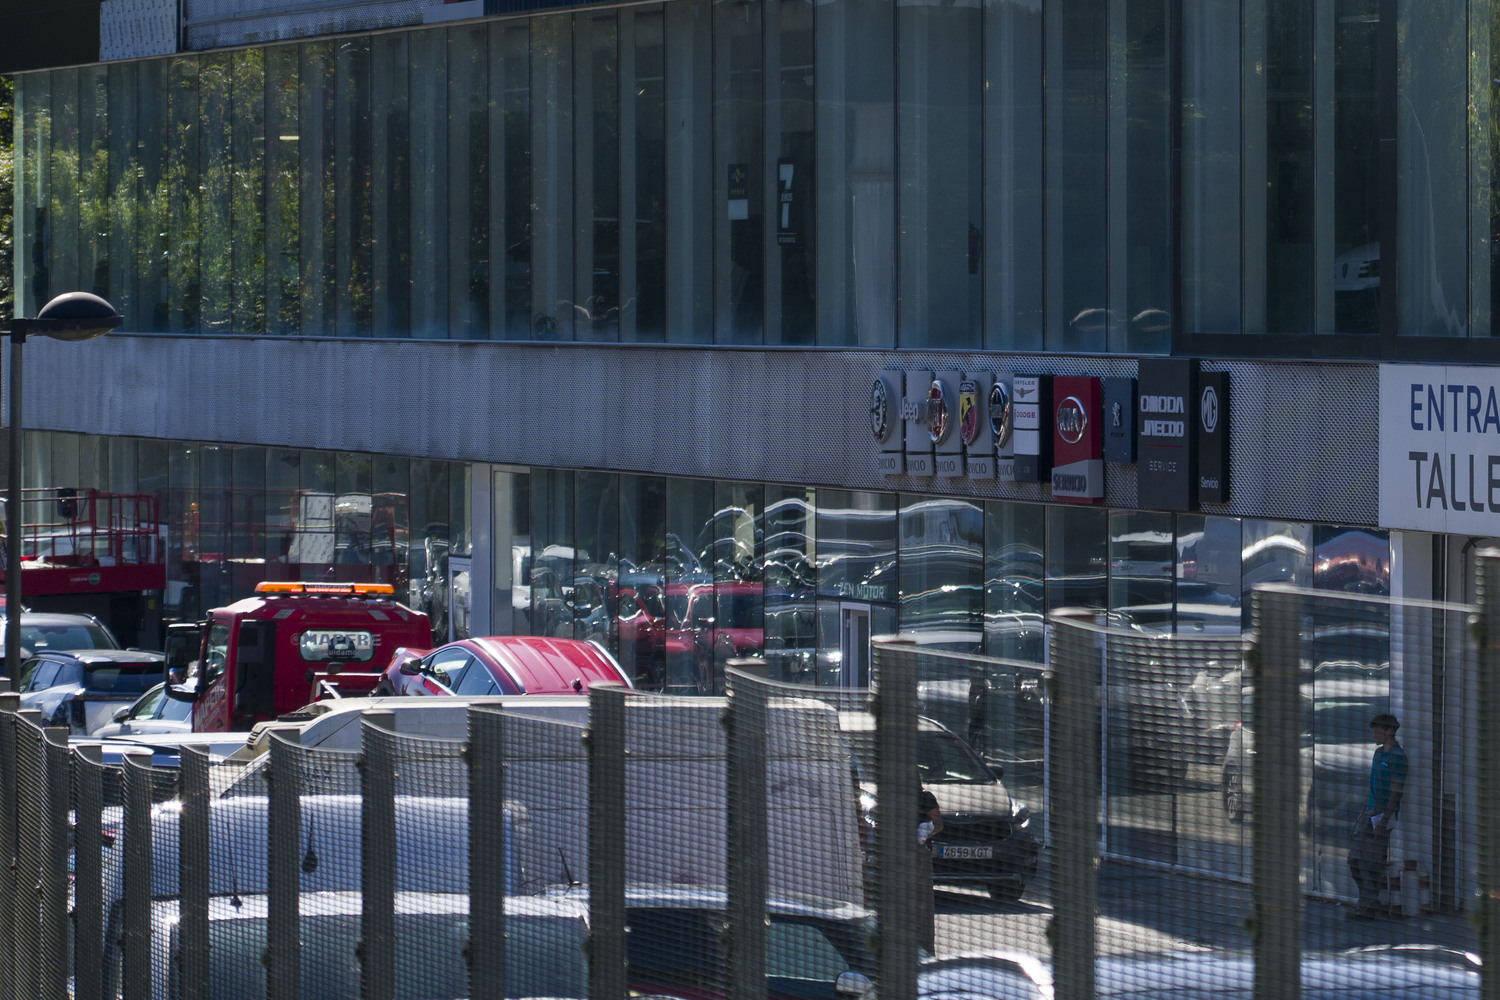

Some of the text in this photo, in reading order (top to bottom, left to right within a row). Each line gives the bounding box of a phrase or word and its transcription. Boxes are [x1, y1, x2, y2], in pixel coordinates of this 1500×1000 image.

[900, 397, 920, 424] Jeep
[1140, 395, 1184, 414] OMODA
[1203, 390, 1217, 430] MG
[1149, 460, 1177, 472] SERVICE
[1052, 473, 1087, 493] SERVICIO
[1200, 476, 1218, 489] Servicio
[304, 633, 381, 646] MAPFRE
[944, 847, 969, 858] 4659
